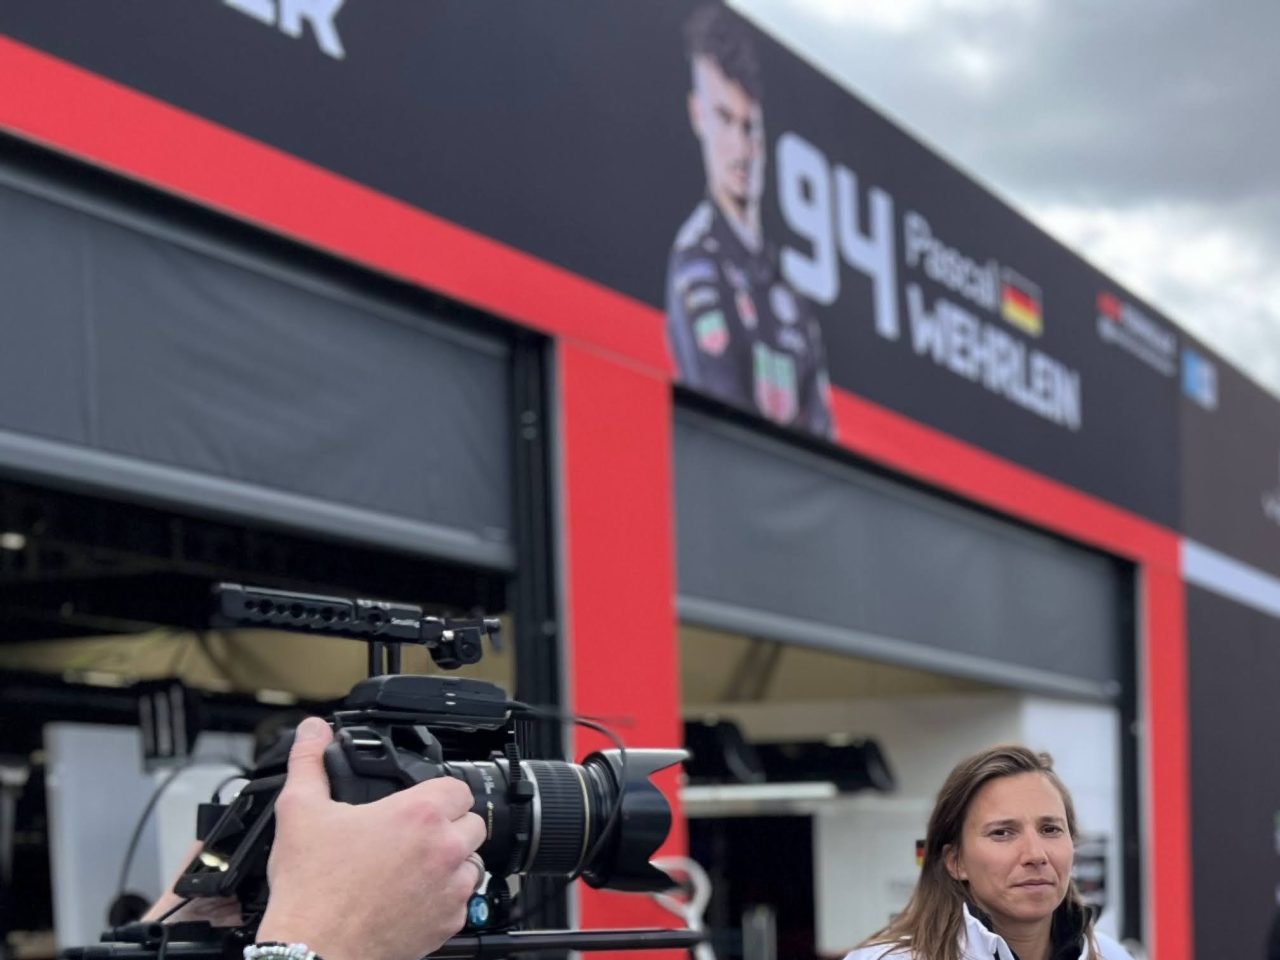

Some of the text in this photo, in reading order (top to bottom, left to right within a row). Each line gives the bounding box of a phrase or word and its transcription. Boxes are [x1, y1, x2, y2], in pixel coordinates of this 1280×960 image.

[774, 131, 899, 342] 94
[904, 209, 1000, 316] Pascal
[904, 281, 1083, 431] WEHRLEIN
